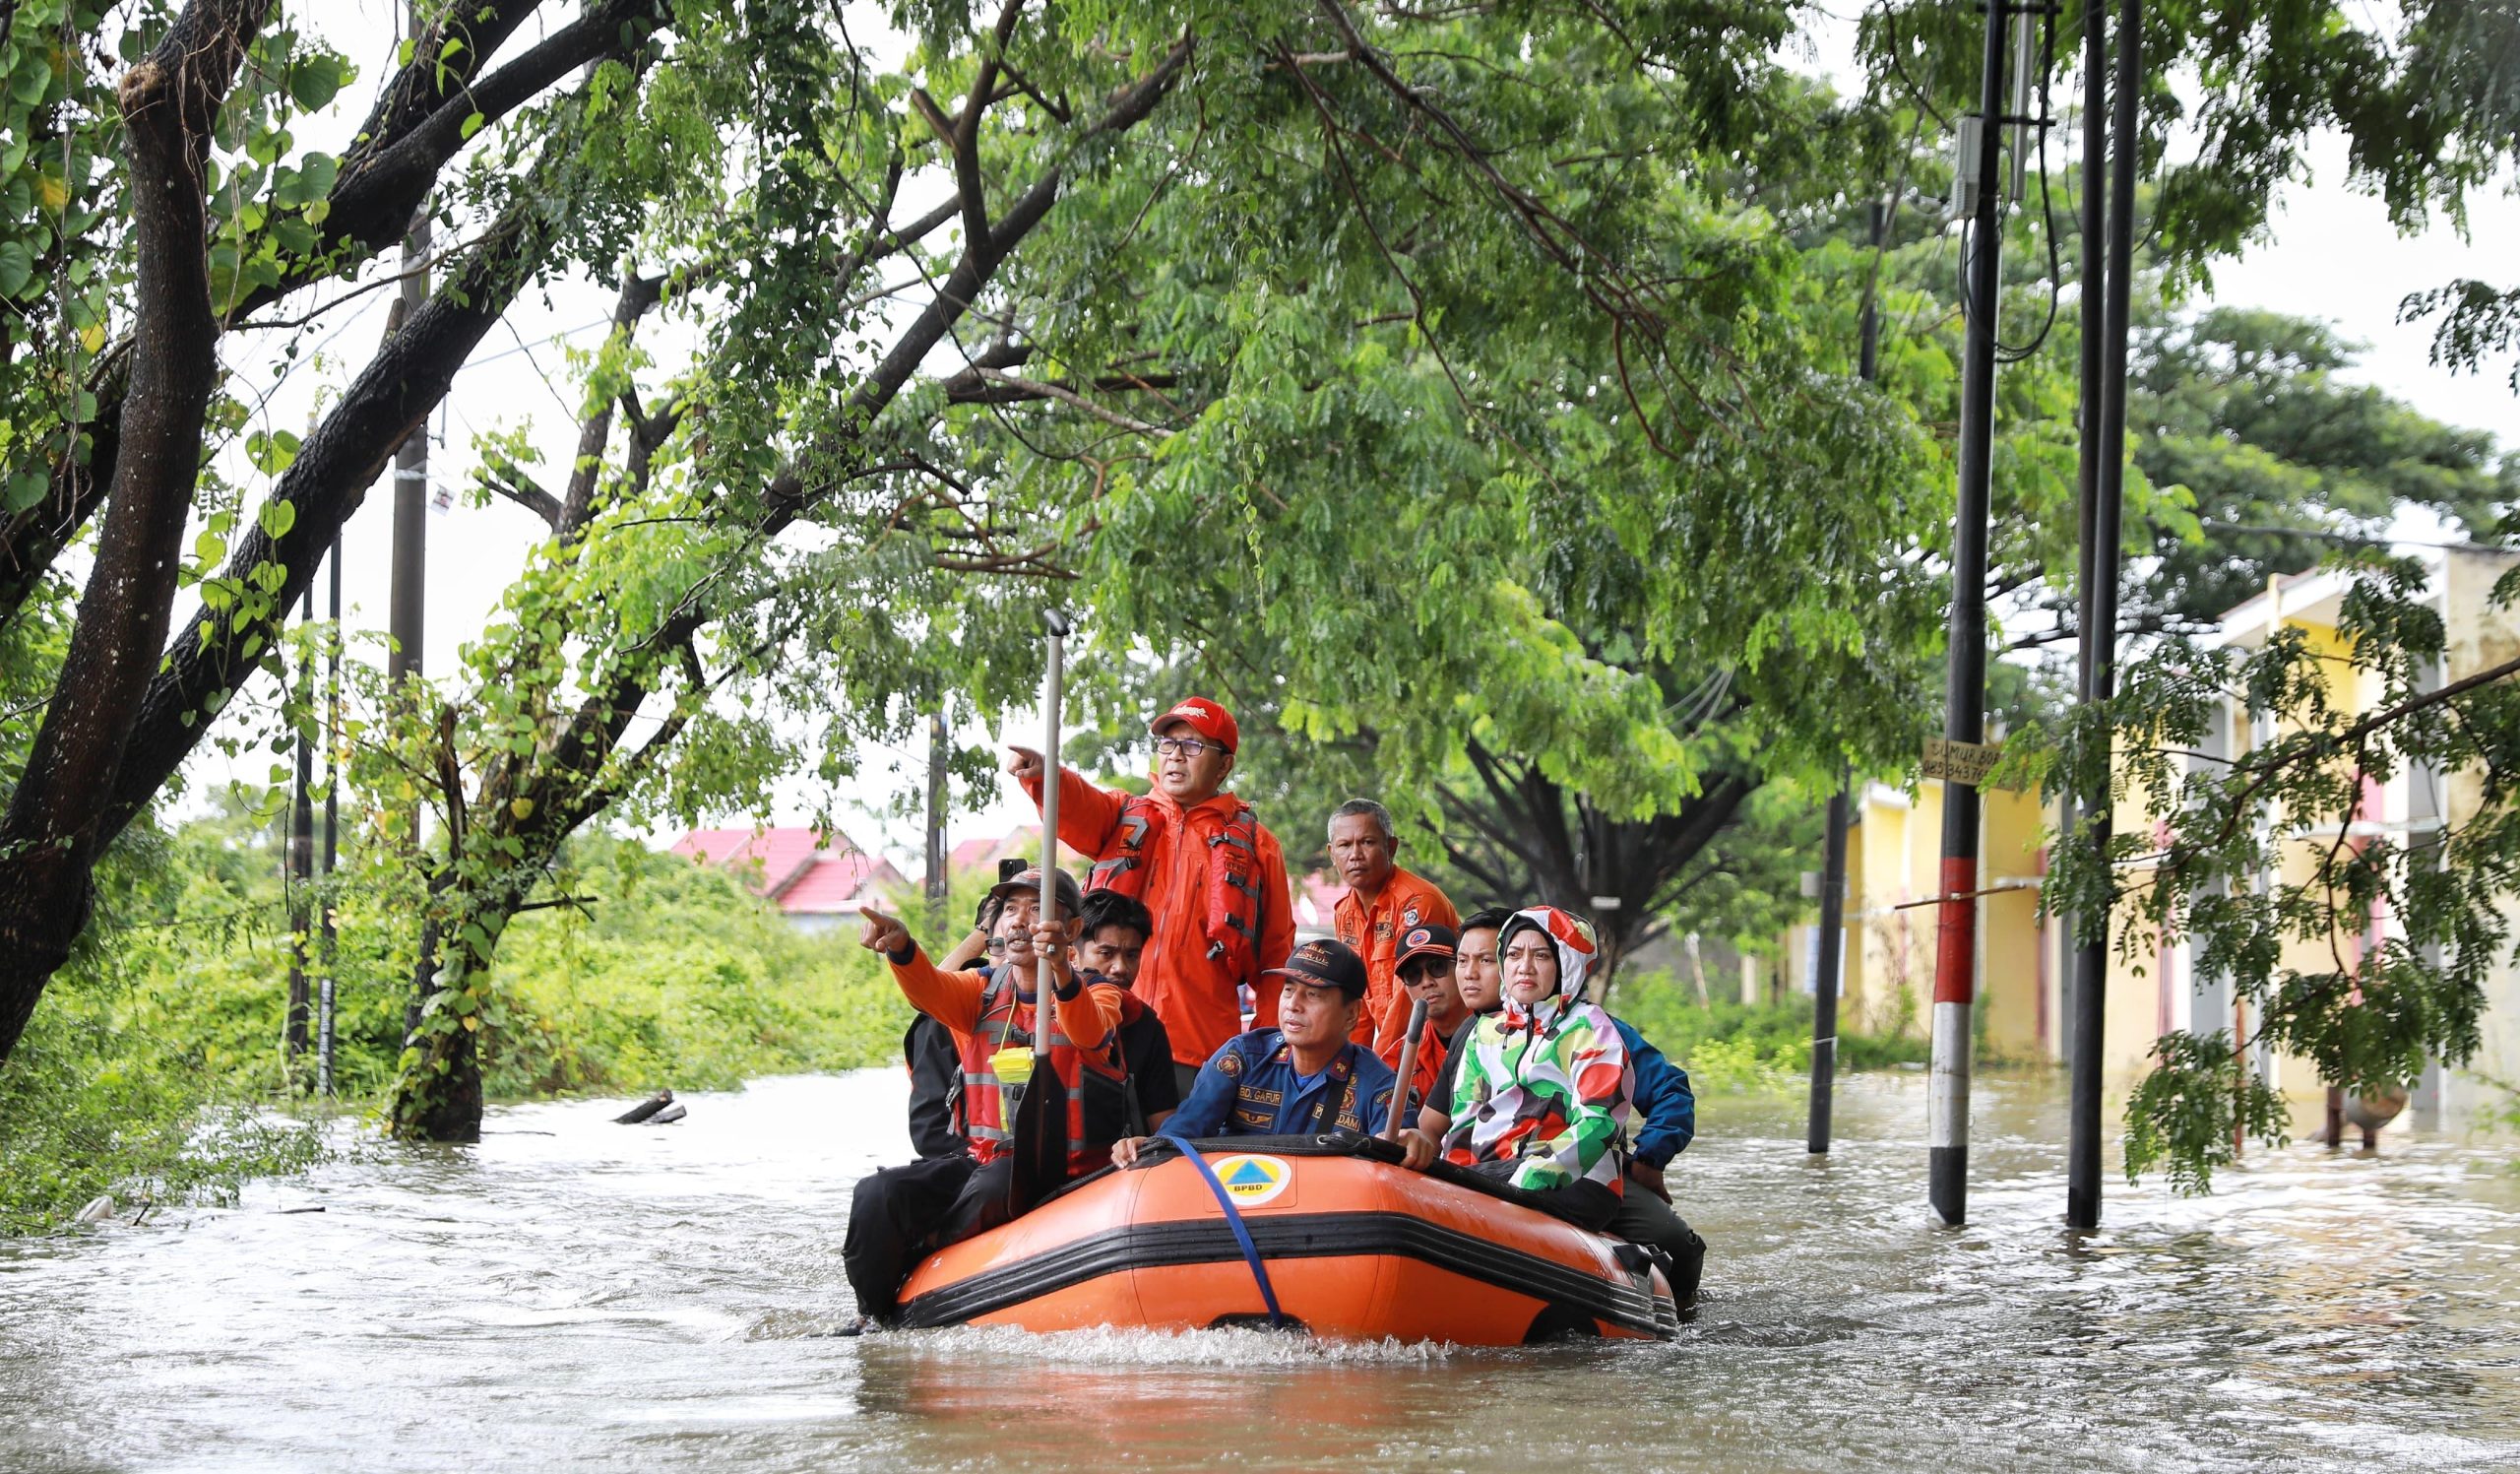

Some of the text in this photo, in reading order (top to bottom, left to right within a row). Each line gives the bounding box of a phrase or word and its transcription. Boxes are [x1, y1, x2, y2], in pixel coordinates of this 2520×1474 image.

[1930, 742, 1976, 763] SUMUR
[1254, 1090, 1281, 1104] GAFUR
[1233, 1184, 1263, 1196] BPBD
